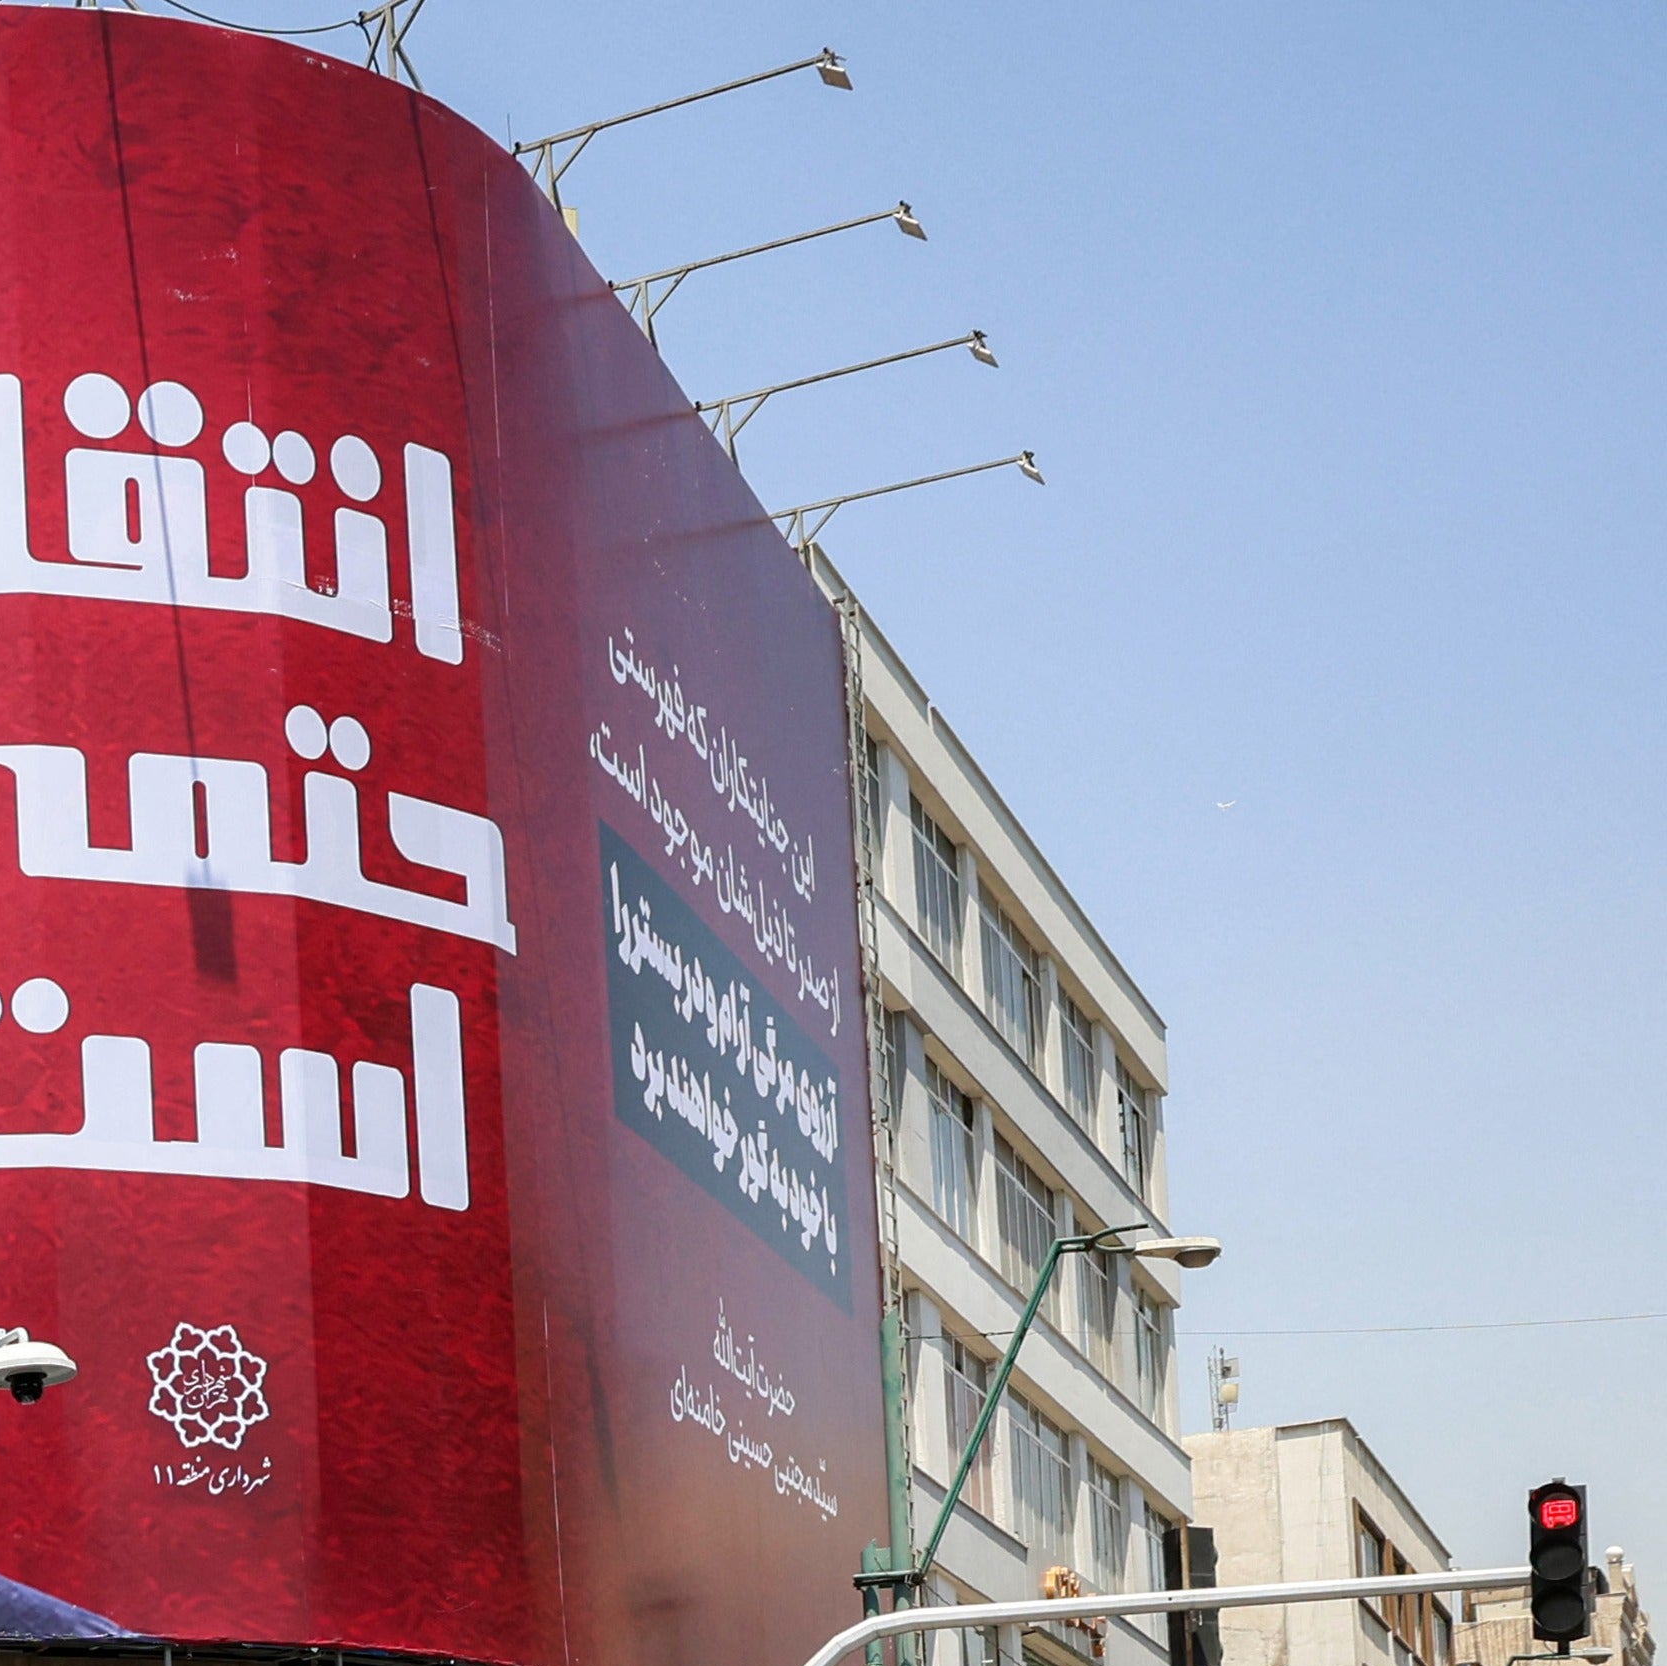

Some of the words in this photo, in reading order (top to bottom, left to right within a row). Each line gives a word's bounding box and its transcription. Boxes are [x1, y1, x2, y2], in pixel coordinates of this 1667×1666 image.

[631, 1022, 665, 1121] برد
[666, 1055, 739, 1173] خواهند
[154, 1465, 173, 1484] ۱۱
[176, 1456, 210, 1486] منطقه
[208, 1456, 271, 1495] شهرداری
